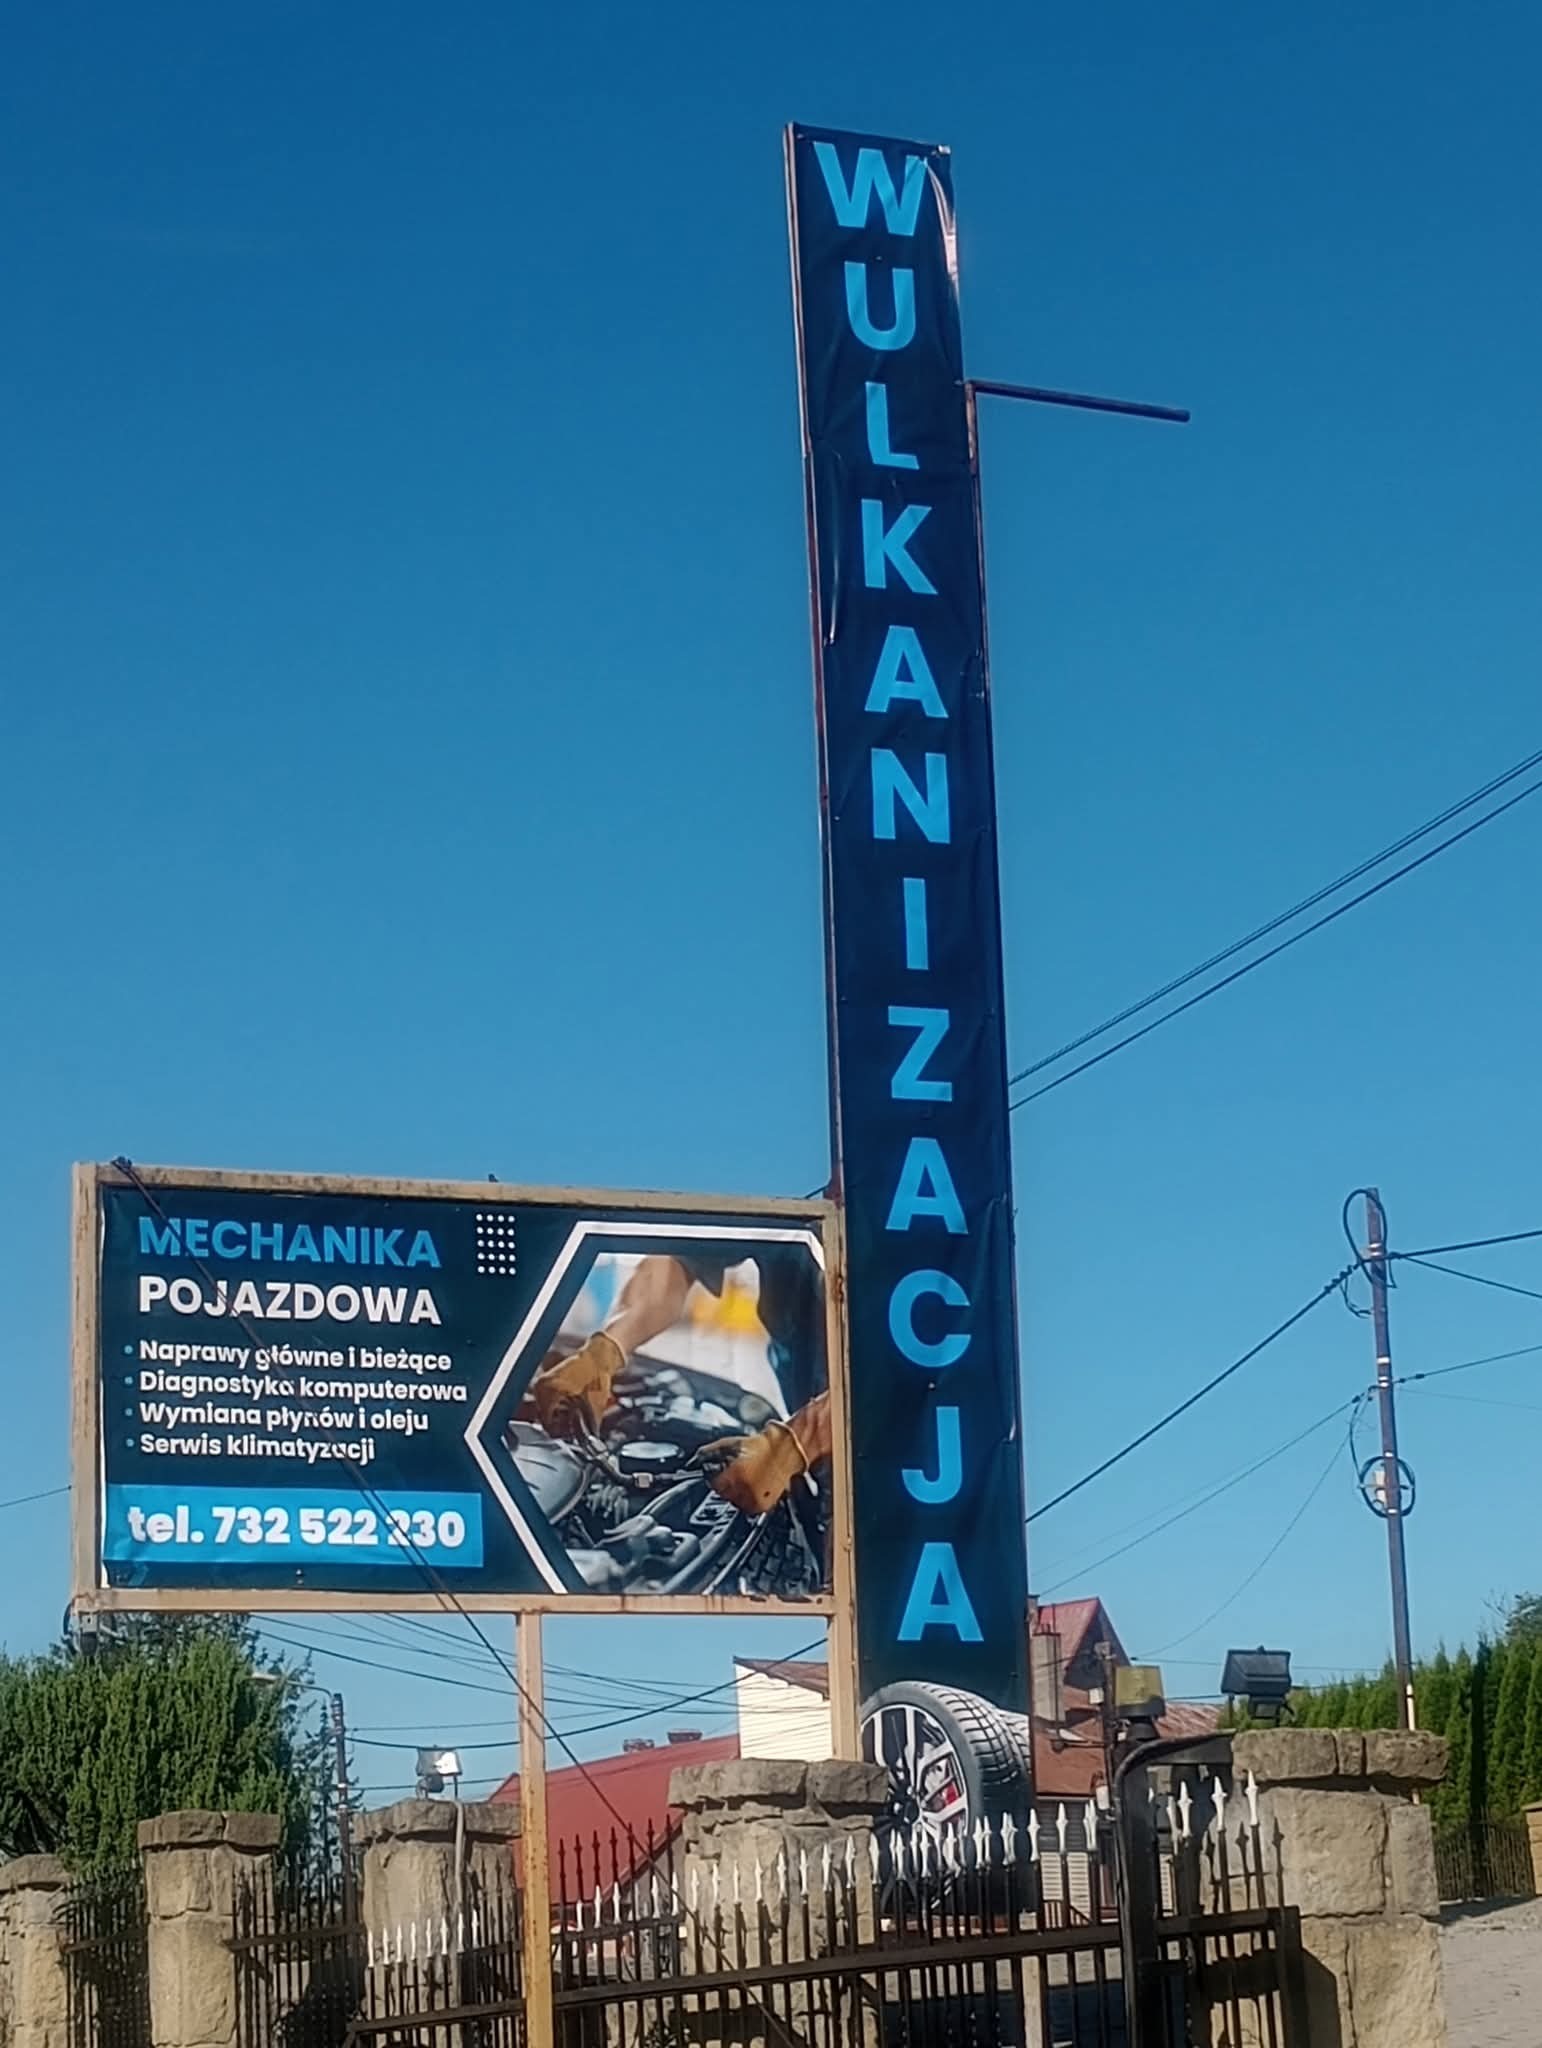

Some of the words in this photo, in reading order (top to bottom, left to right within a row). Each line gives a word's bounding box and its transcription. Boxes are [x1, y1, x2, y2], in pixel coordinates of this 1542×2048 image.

[813, 140, 985, 1643] WULKANIZACJA
[138, 1216, 441, 1268] MECHANIKA
[138, 1275, 441, 1325] POJAZDOWA
[139, 1340, 249, 1368] Naprawy
[255, 1344, 344, 1371] główne
[348, 1345, 356, 1368] i
[360, 1347, 452, 1375] bieżące
[139, 1371, 295, 1401] Diagnostyka
[299, 1376, 468, 1404] komputerowa
[139, 1402, 262, 1429] Wymiana
[266, 1406, 354, 1433] płynów
[359, 1408, 366, 1429] i
[370, 1409, 429, 1435] oleju
[140, 1434, 221, 1456] Serwis
[227, 1435, 375, 1465] klimatyzacji
[128, 1505, 205, 1543] tel.
[212, 1507, 290, 1544] 732
[300, 1508, 378, 1545] 522
[386, 1511, 465, 1548] 230
